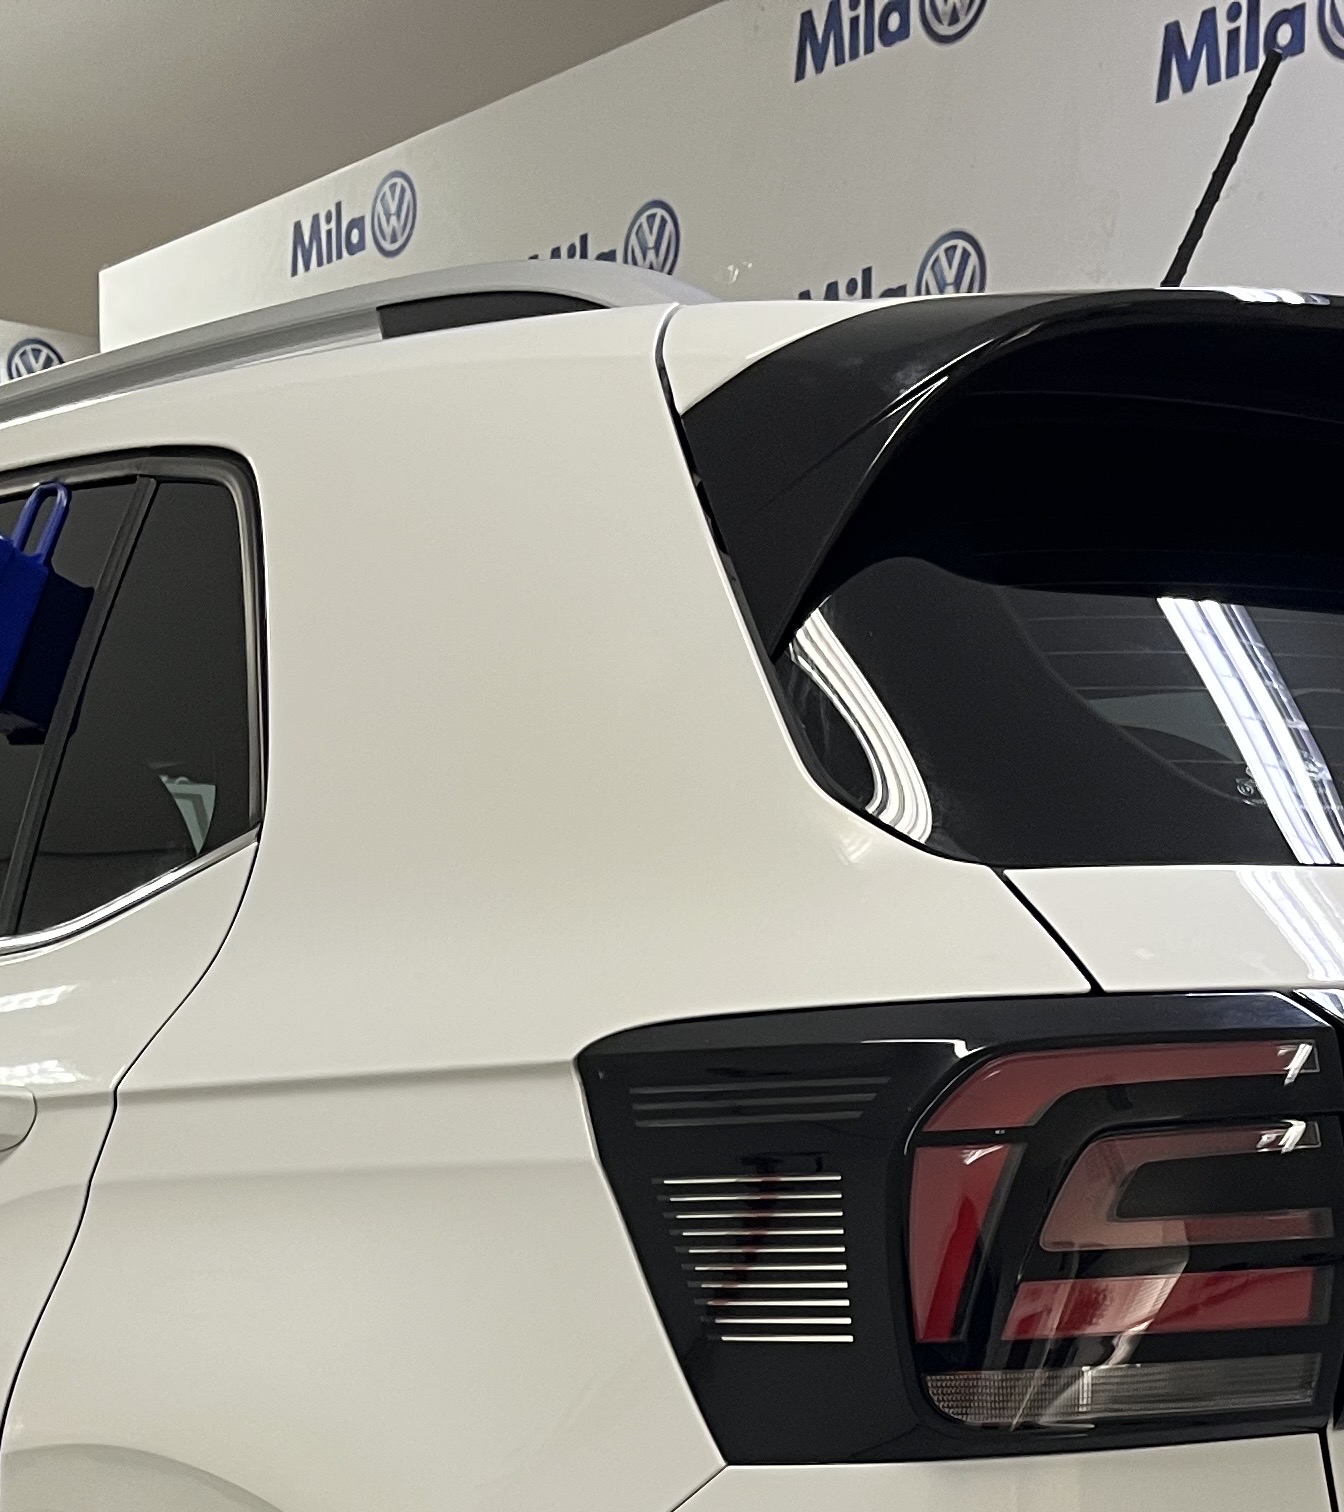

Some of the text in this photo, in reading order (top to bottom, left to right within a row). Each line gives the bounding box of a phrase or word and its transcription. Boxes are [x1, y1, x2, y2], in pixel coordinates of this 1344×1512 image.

[794, 0, 911, 83] Mila
[1155, 0, 1306, 103] Mila
[289, 198, 367, 278] Mila
